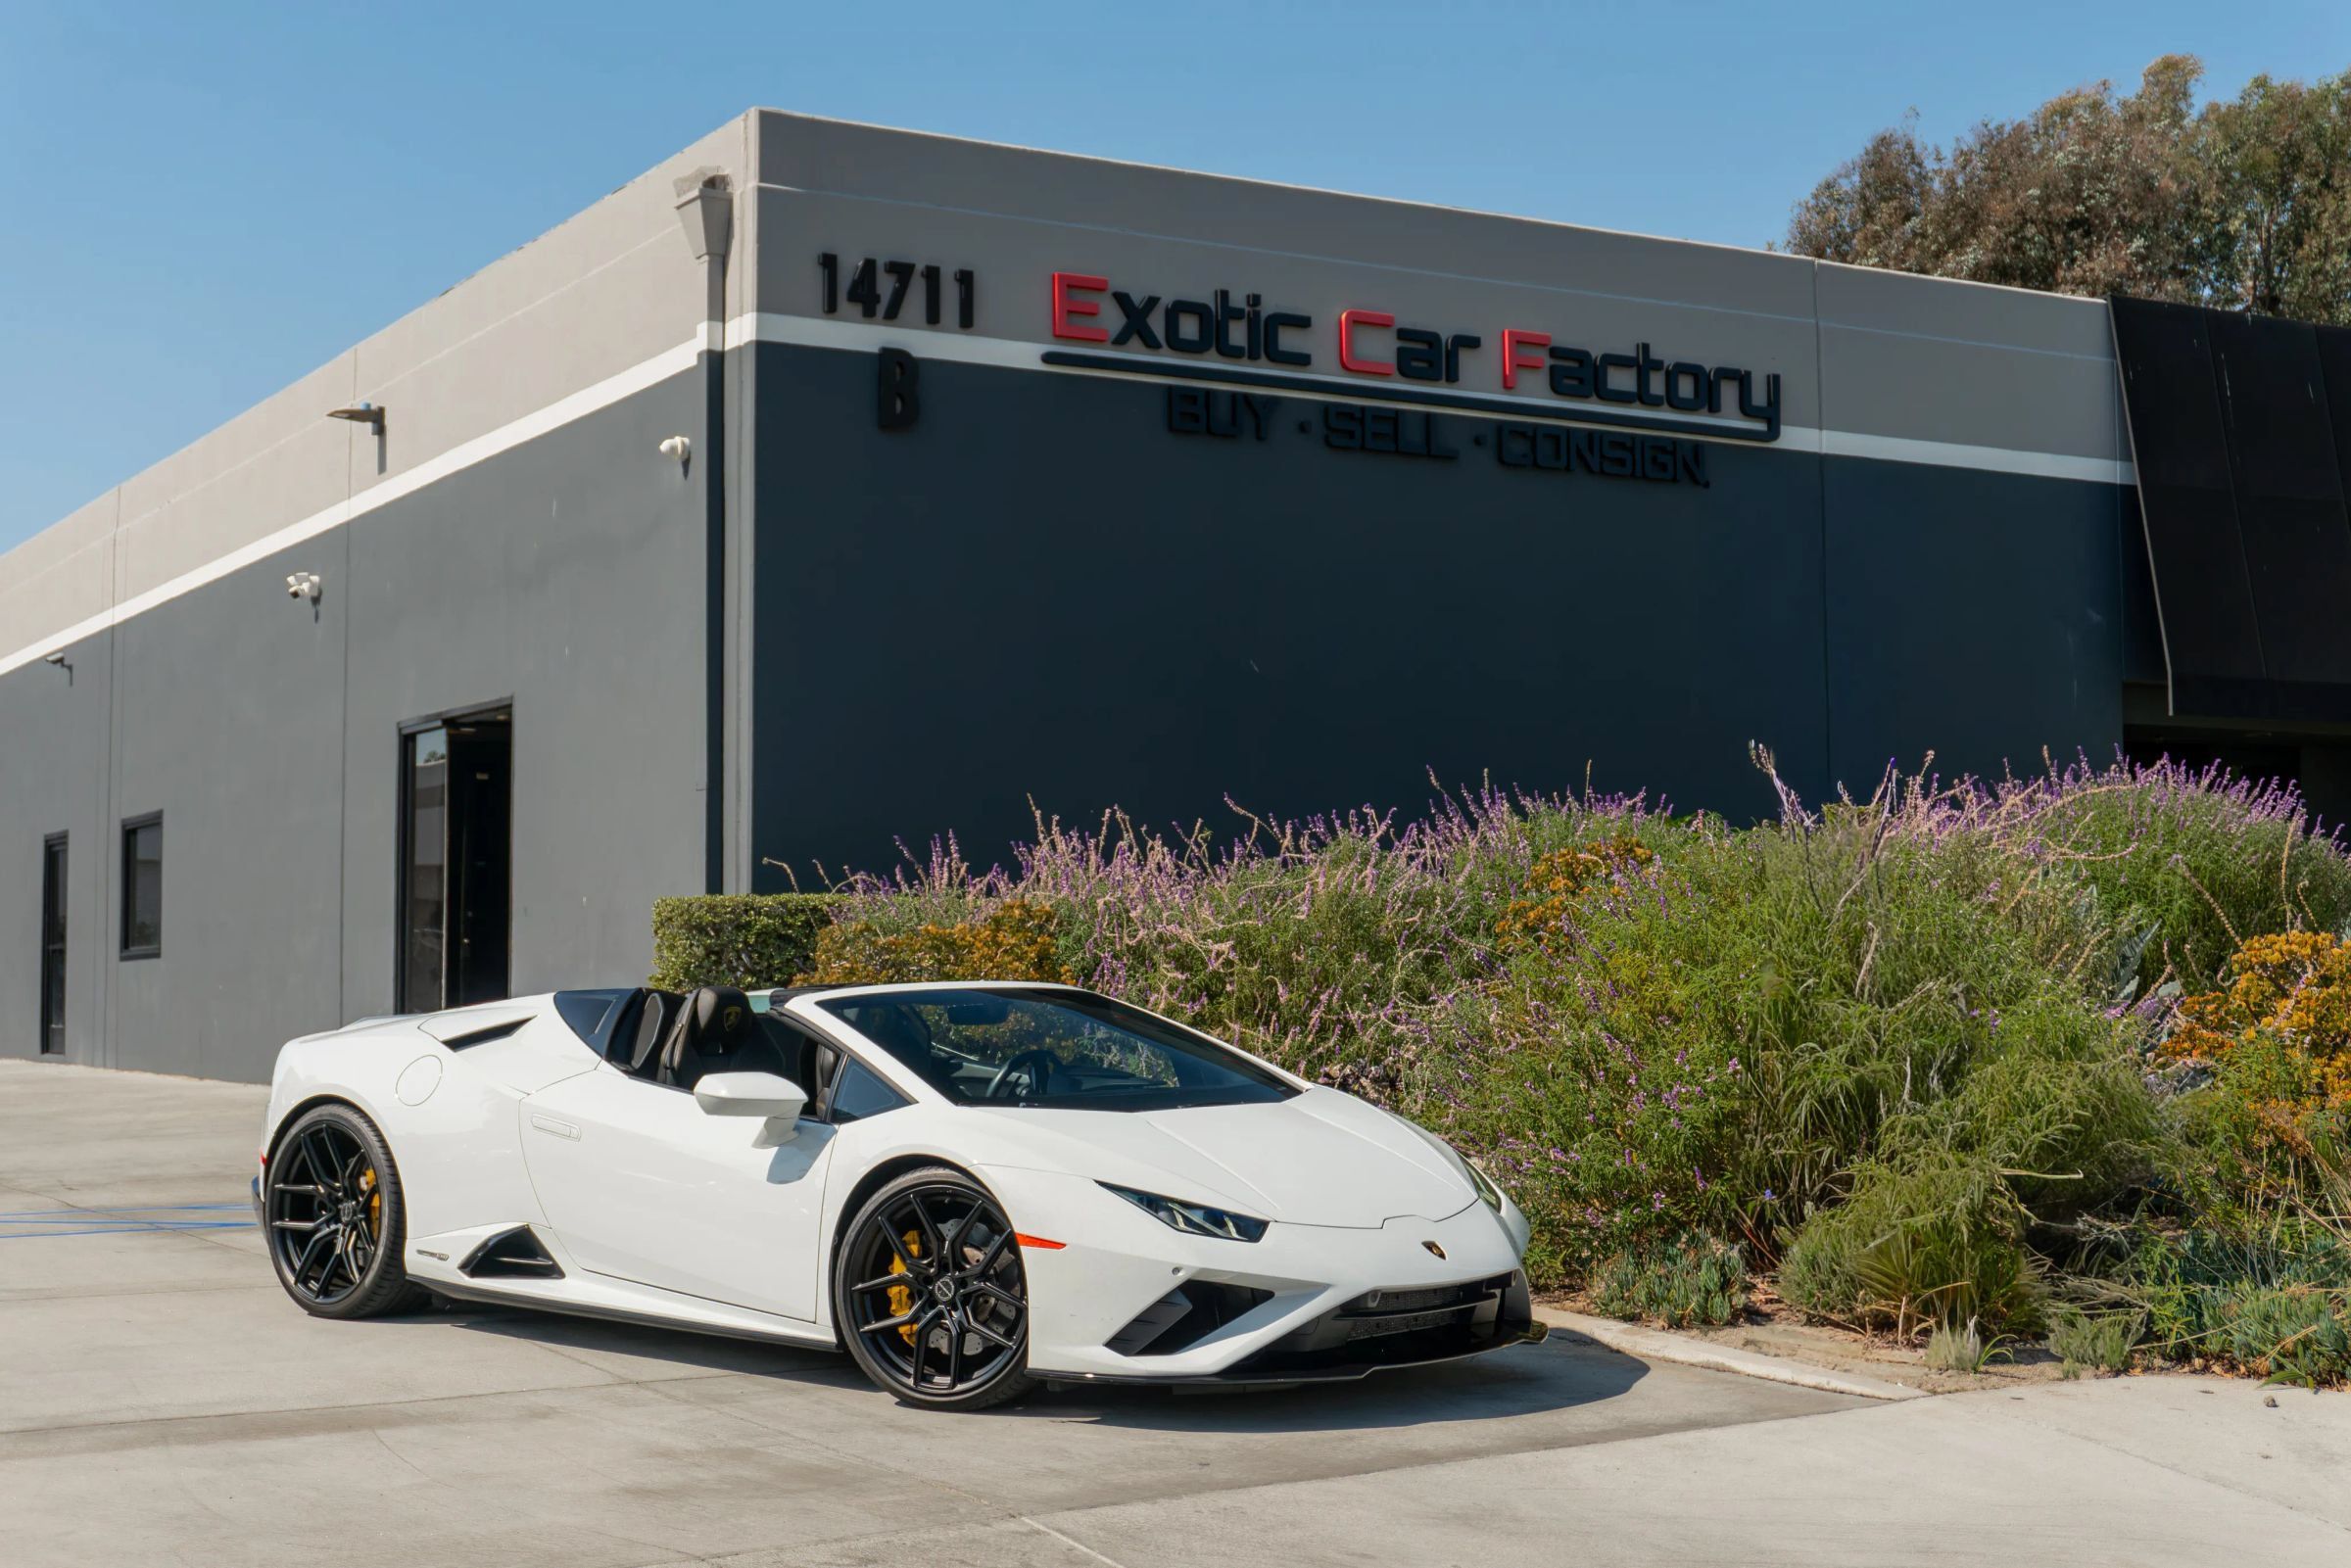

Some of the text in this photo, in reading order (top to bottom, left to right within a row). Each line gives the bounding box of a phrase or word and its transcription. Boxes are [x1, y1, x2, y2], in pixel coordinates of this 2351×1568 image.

[818, 253, 974, 328] 14711
[879, 347, 920, 430] B
[1051, 271, 1781, 443] Exotic Car Factory
[1167, 385, 1277, 441] BUY
[1324, 405, 1459, 459] SELL
